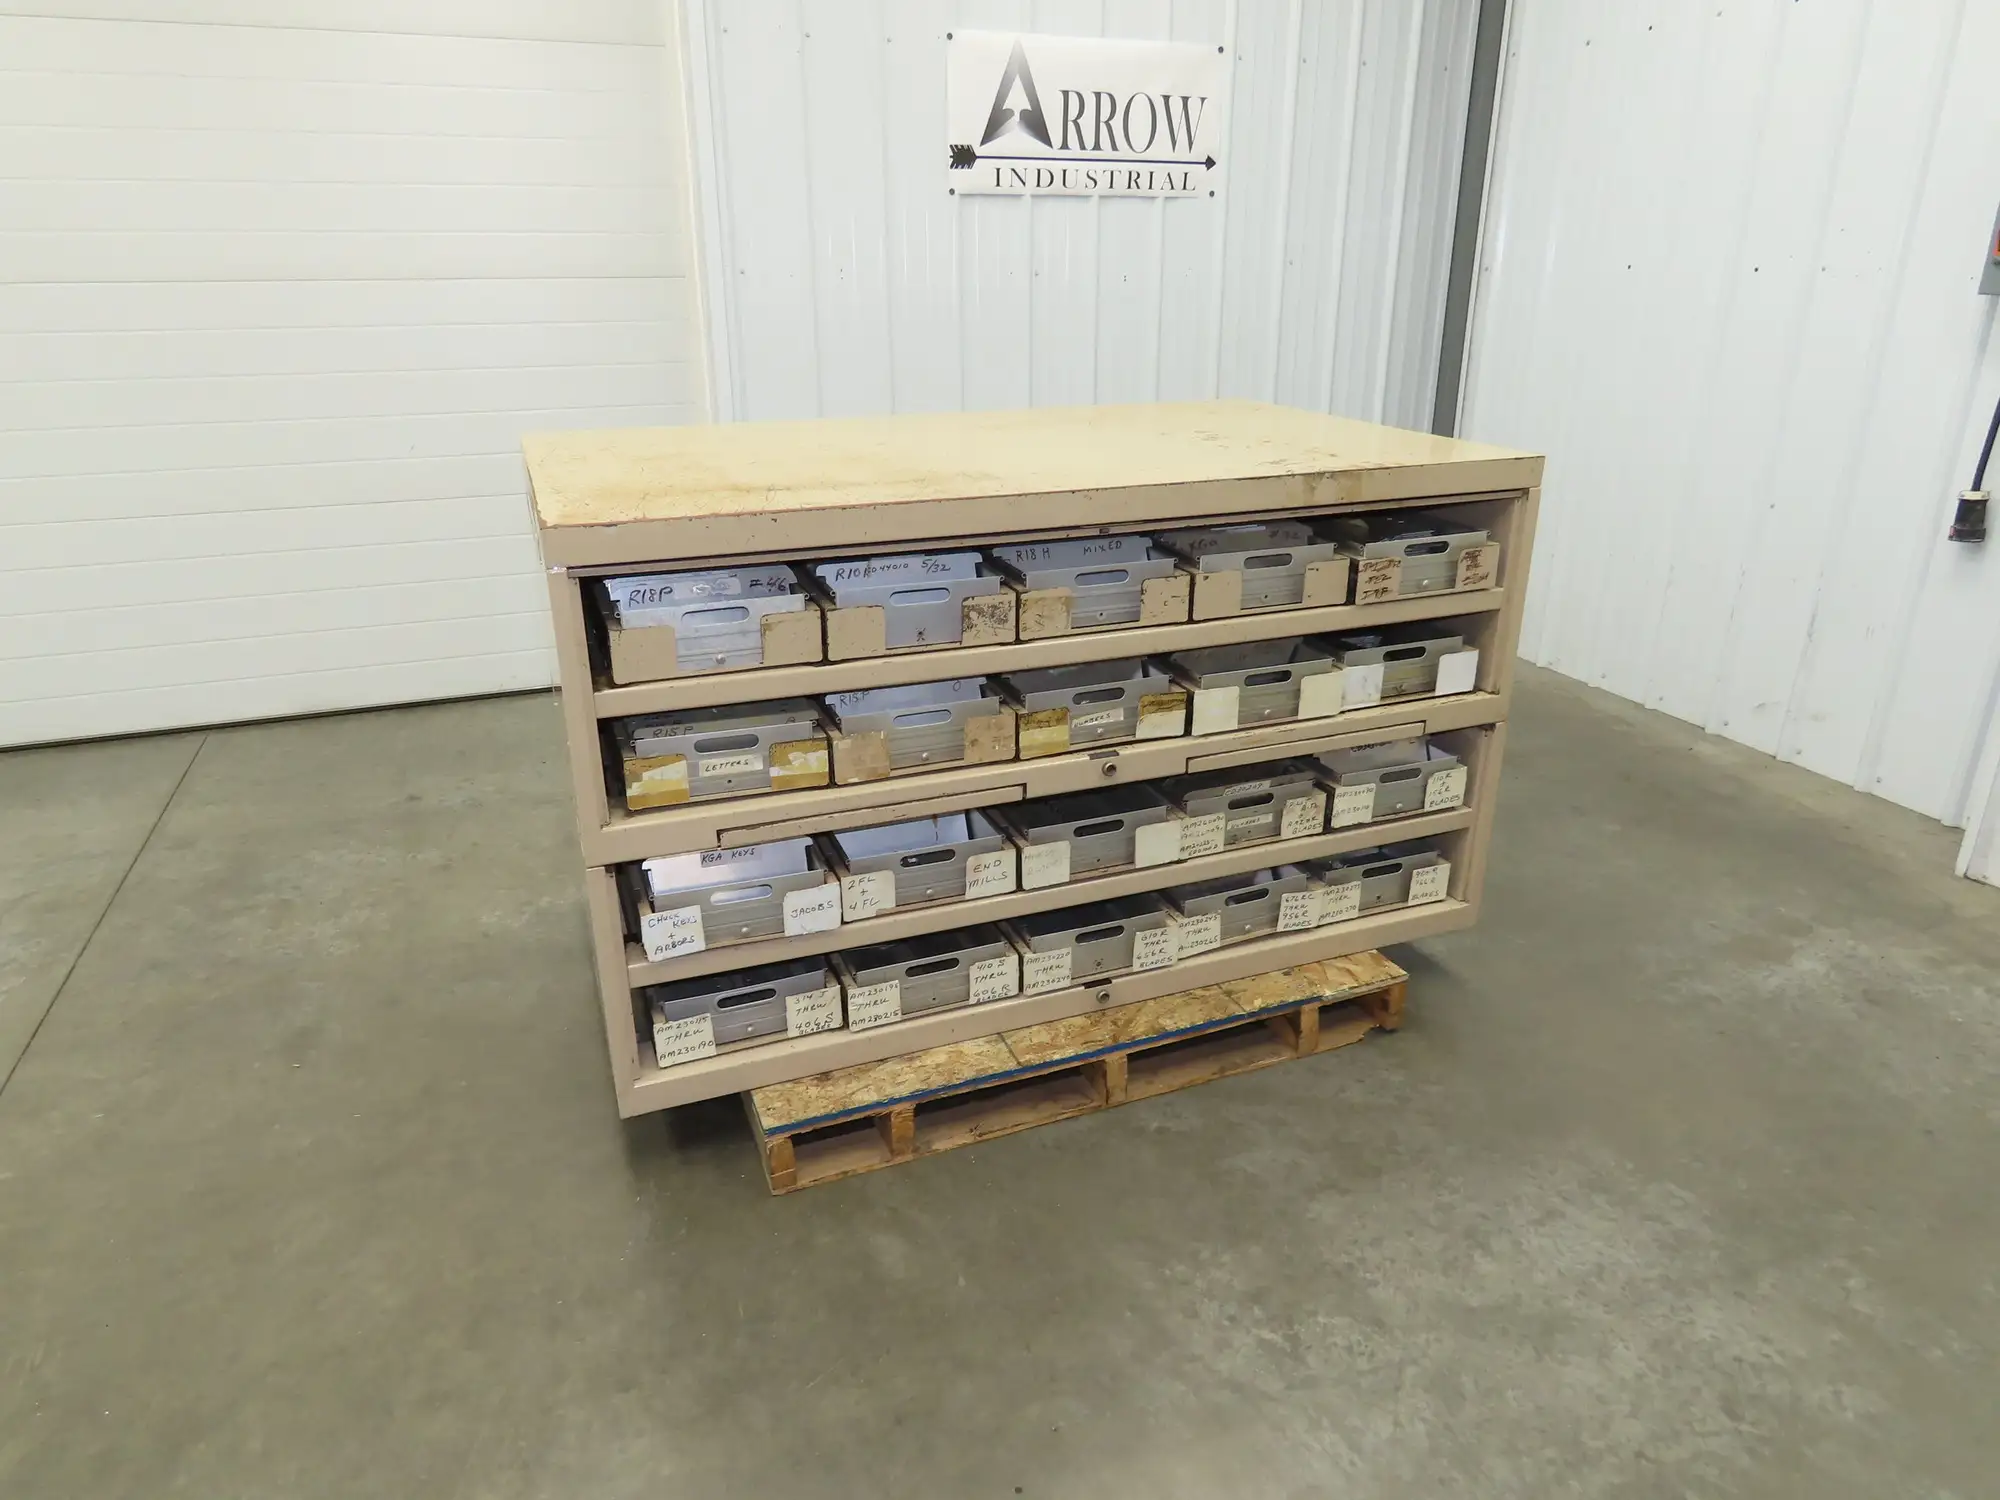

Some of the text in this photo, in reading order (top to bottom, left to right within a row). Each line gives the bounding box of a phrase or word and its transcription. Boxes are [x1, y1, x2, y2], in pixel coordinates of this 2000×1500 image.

[979, 35, 1208, 154] ARROW
[993, 167, 1197, 192] INDUSTRIAL
[1083, 540, 1123, 556] MIXED
[920, 558, 952, 576] 5/32
[704, 760, 750, 773] LETTERS
[701, 848, 756, 866] KGA KEYS
[973, 859, 1002, 873] END
[968, 871, 1008, 890] MILLS
[790, 901, 834, 918] JACOBS
[648, 912, 680, 928] CHUCK
[672, 916, 698, 929] KEYS
[1185, 926, 1211, 939] THRU
[654, 936, 695, 956] ARBORS
[1143, 939, 1170, 949] THRU
[1138, 956, 1173, 968] BLADES
[974, 971, 1008, 985] THRU
[1034, 964, 1064, 977] THRU
[796, 1002, 827, 1016] THRU
[857, 997, 890, 1012] THRU
[665, 1028, 704, 1046] THRU
[659, 1040, 714, 1061] AM230190
